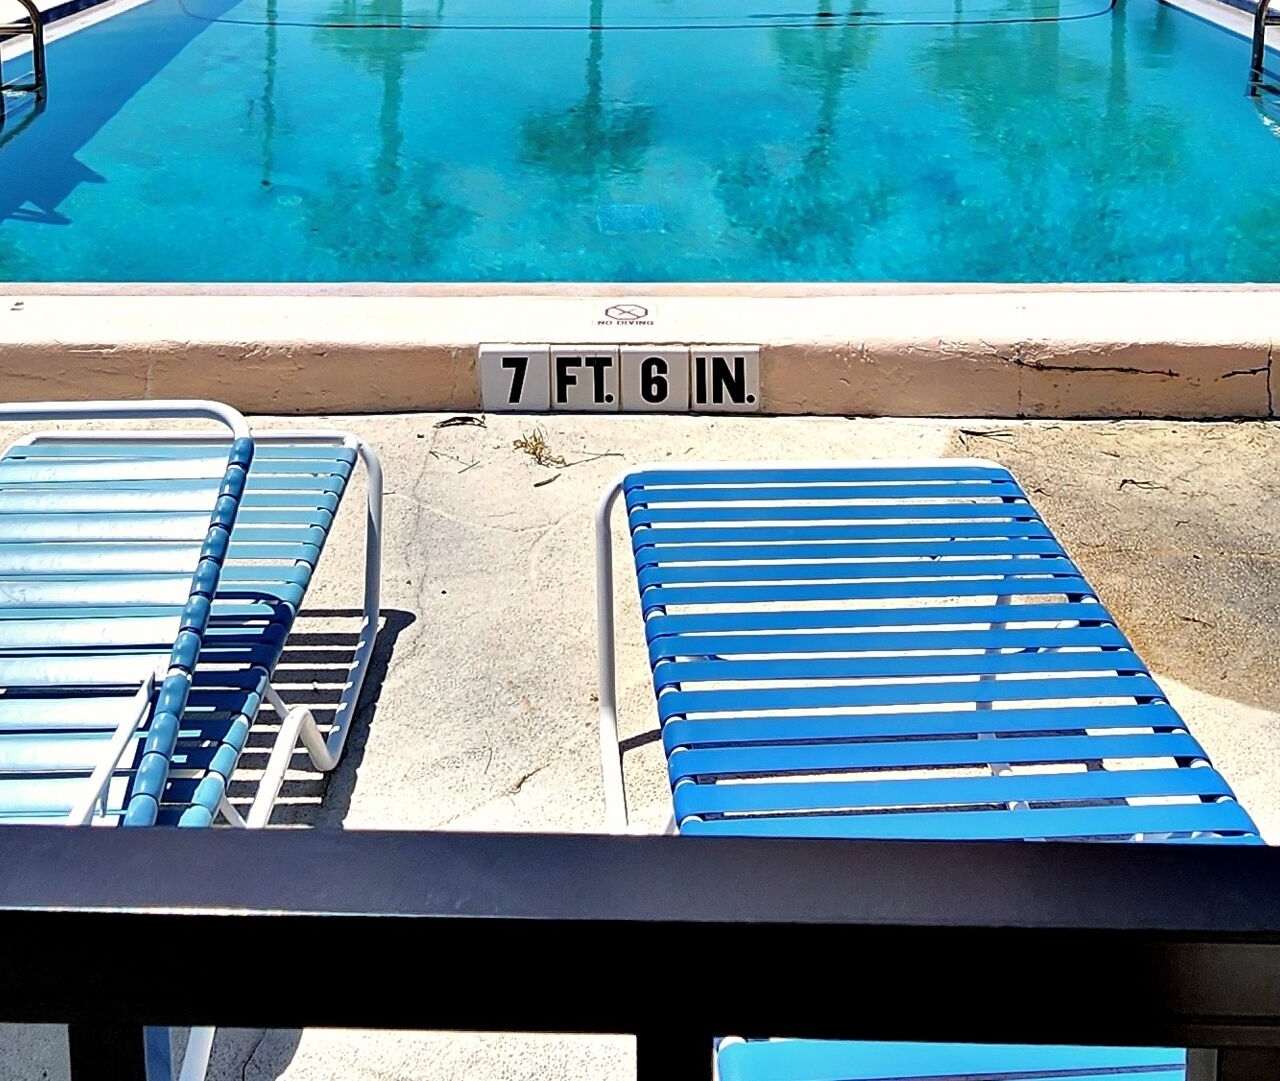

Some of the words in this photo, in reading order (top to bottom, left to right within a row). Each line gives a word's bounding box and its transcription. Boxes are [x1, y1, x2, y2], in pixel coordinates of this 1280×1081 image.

[502, 356, 528, 404] 7
[556, 356, 614, 404] FT.
[641, 356, 668, 404] 6
[695, 356, 756, 404] IN.
